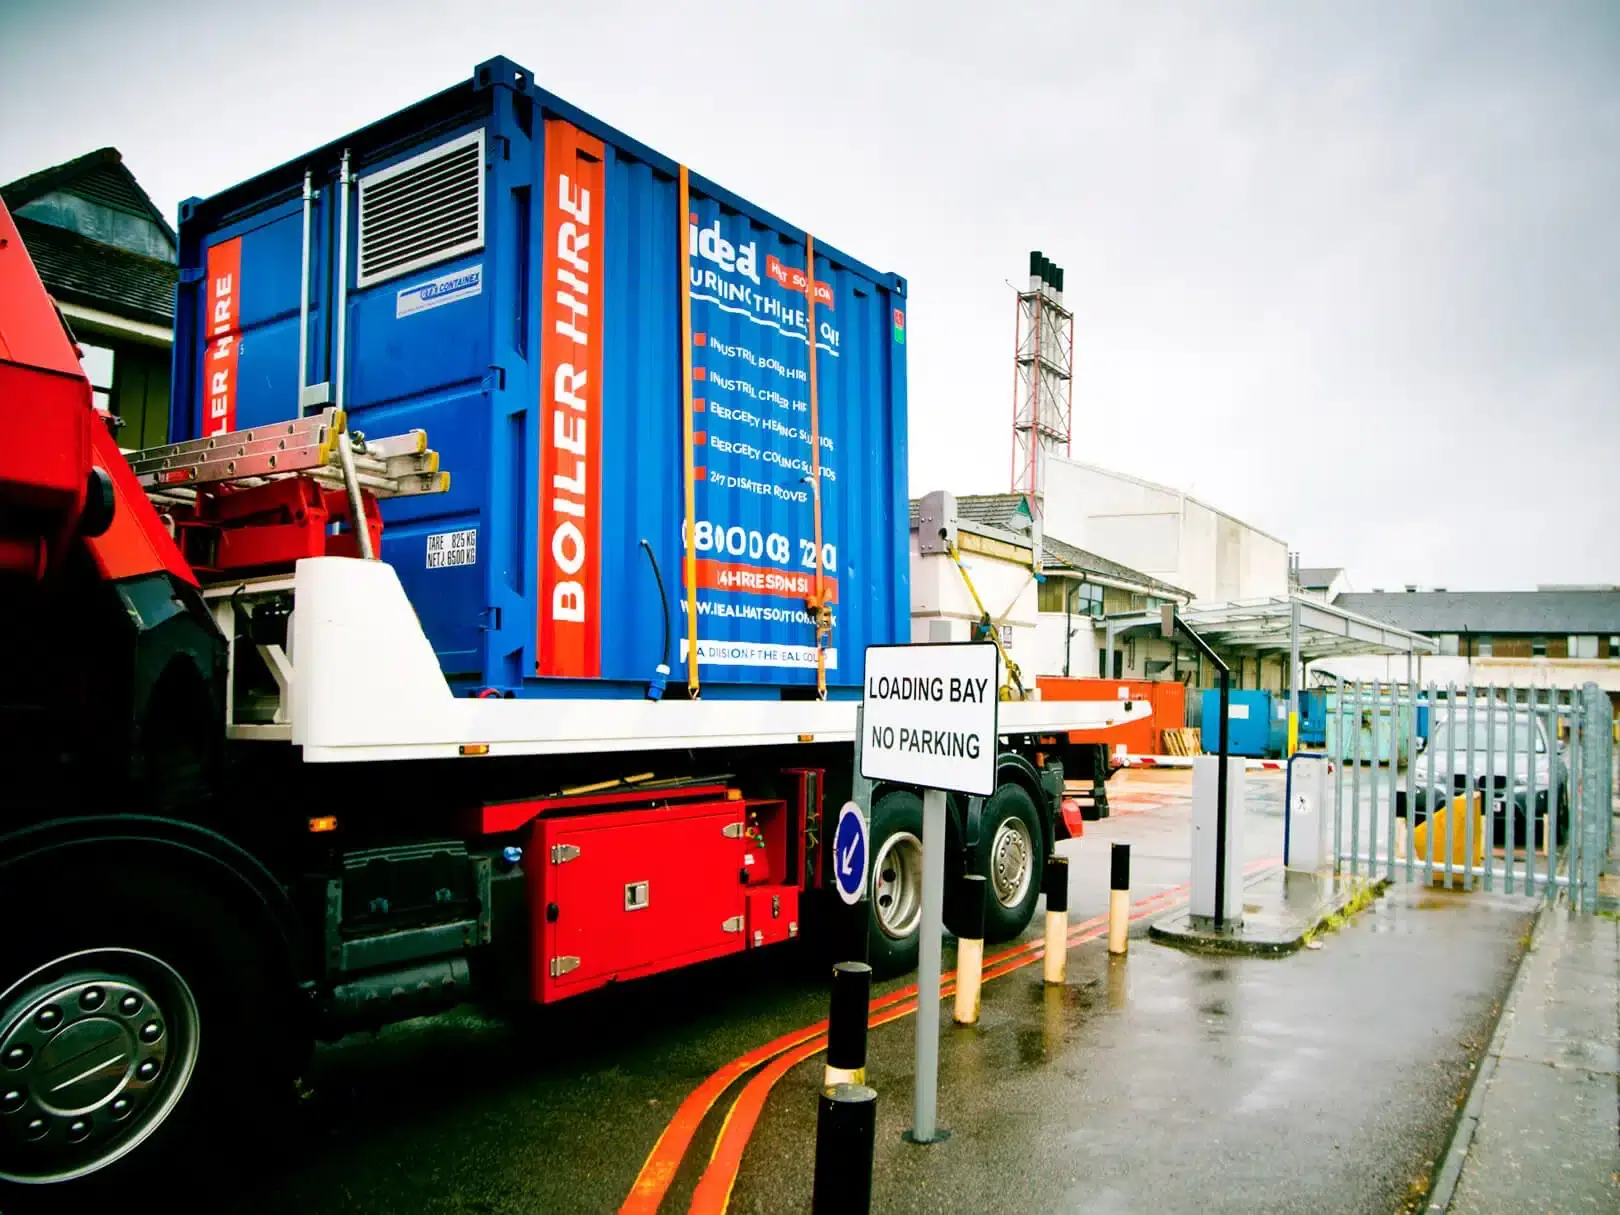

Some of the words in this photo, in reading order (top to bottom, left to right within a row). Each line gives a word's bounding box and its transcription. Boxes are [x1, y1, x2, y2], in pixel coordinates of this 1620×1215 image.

[556, 174, 590, 345] HIRE
[214, 272, 232, 360] HIRE
[787, 368, 807, 382] HIR
[210, 369, 229, 437] LER
[552, 363, 586, 622] BOILER
[727, 476, 772, 495] DISATER
[429, 535, 444, 550] TARE
[452, 532, 464, 548] 825
[466, 530, 475, 546] KG
[447, 549, 464, 565] 6500
[466, 547, 475, 563] KG
[869, 676, 944, 702] LOADING
[949, 677, 989, 704] BAY
[871, 725, 895, 750] NO
[899, 727, 980, 760] PARKING
